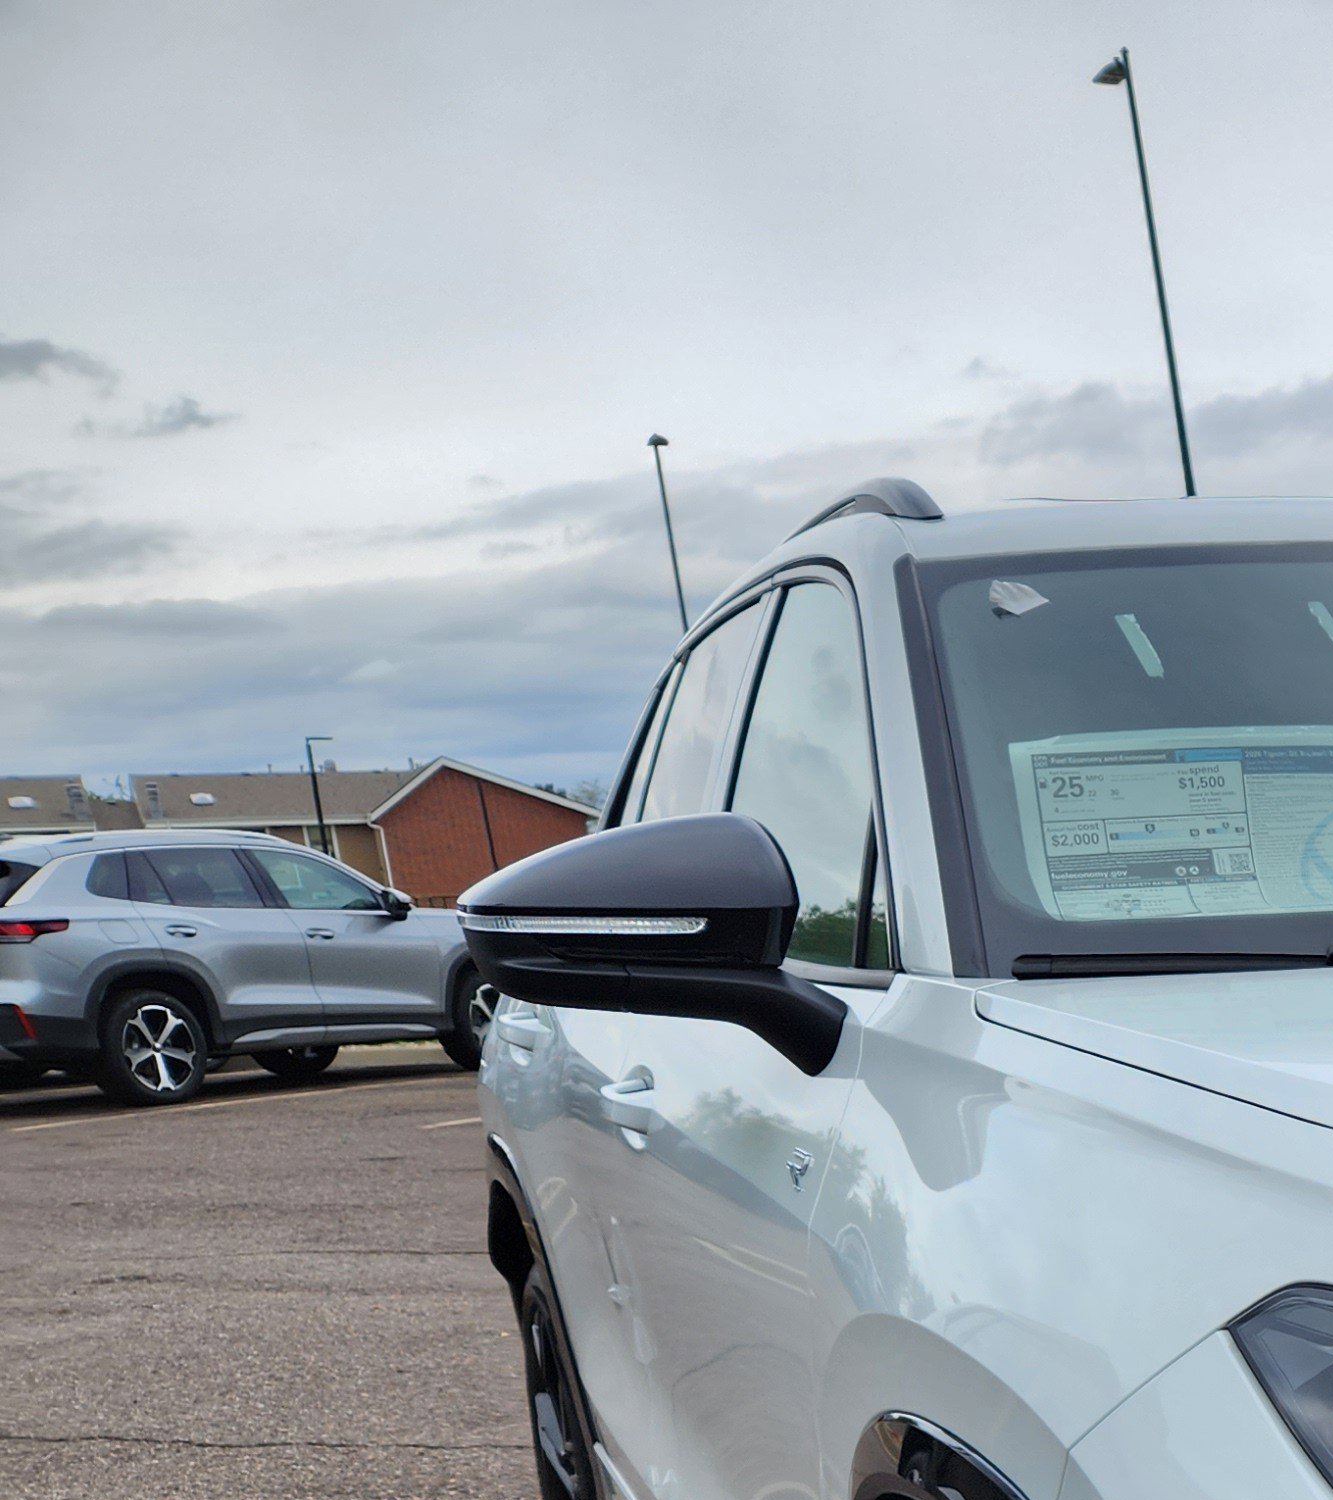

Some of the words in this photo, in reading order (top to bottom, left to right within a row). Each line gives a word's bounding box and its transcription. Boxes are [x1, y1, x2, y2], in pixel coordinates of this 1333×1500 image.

[1189, 764, 1220, 775] spend
[1051, 775, 1084, 799] 25
[1178, 775, 1226, 791] $1,500
[1077, 822, 1099, 831] cost
[1051, 832, 1100, 847] $2,000
[1051, 868, 1128, 880] fueleconomy.gov
